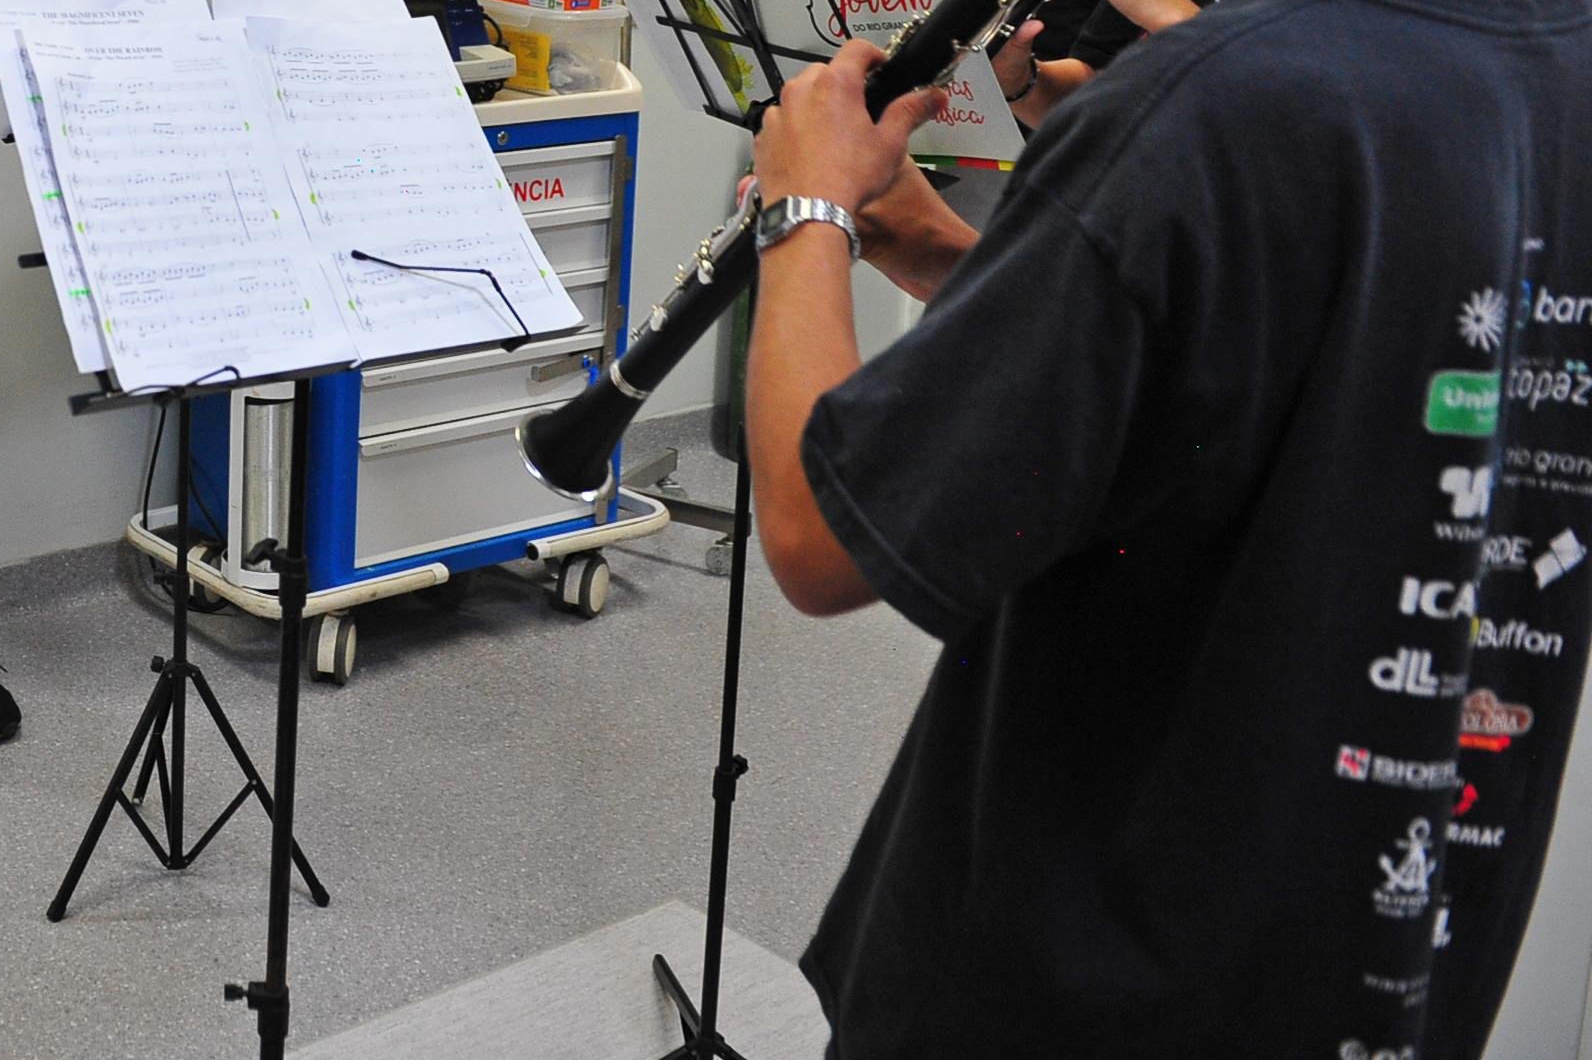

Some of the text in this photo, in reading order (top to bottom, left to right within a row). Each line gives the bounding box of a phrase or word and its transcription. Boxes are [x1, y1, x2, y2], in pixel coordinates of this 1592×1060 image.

[852, 22, 906, 33] DO RIO GRAN
[512, 177, 565, 202] NCIA
[1477, 618, 1564, 657] Buffon
